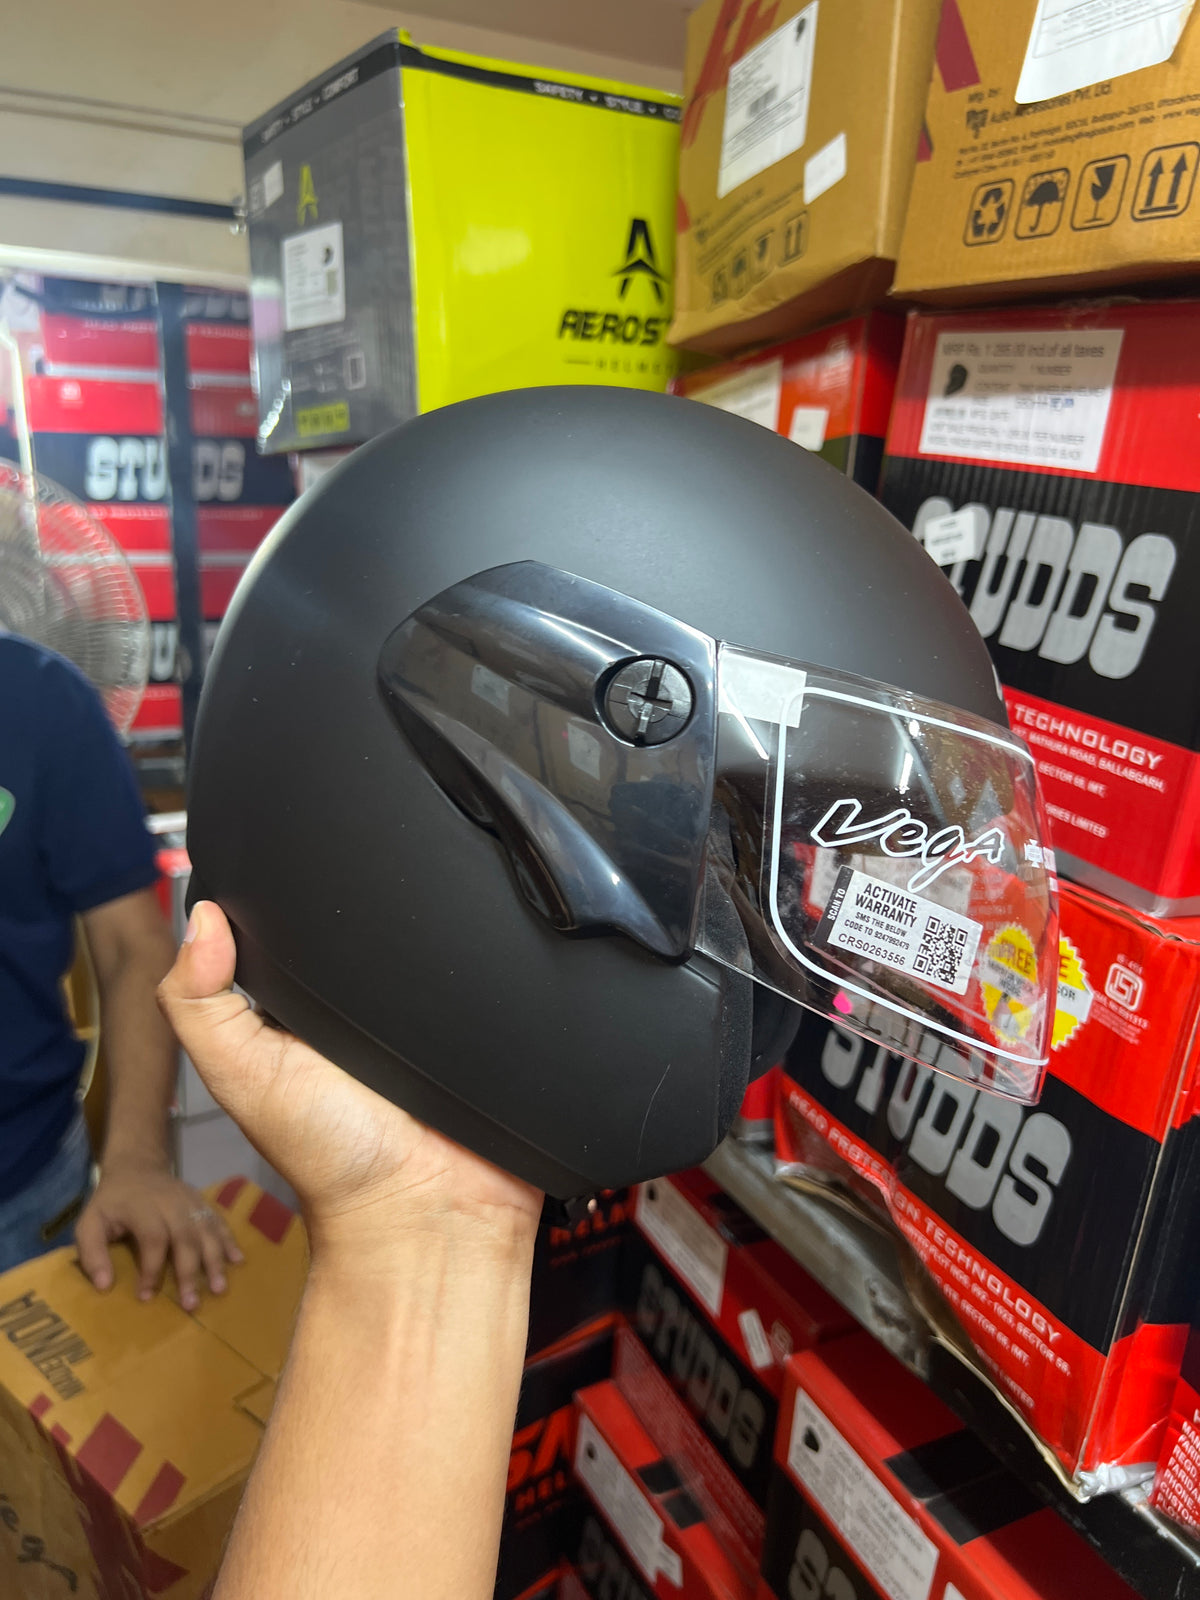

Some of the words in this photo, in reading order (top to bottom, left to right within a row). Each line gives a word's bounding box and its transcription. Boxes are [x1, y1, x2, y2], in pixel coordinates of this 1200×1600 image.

[84, 436, 246, 501] STUDS
[1014, 703, 1164, 770] TECHNOLOGY
[1038, 761, 1074, 785] SECTOR
[1070, 815, 1109, 839] LIMITED
[827, 899, 842, 921] SCAN
[835, 888, 846, 901] TO
[855, 893, 918, 928] WARRANTY
[863, 882, 918, 914] ACTIVATE
[844, 919, 862, 932] CODE
[864, 926, 874, 936] TO
[855, 911, 871, 924] SMS
[871, 917, 885, 929] THE
[885, 922, 908, 938] BELOW
[838, 933, 906, 966] CRS0263556
[789, 1090, 828, 1132] HEAD
[924, 1216, 1061, 1343] TECHNOLOGY
[960, 1298, 997, 1337] SECTOR
[1016, 1321, 1056, 1363] SECTOR
